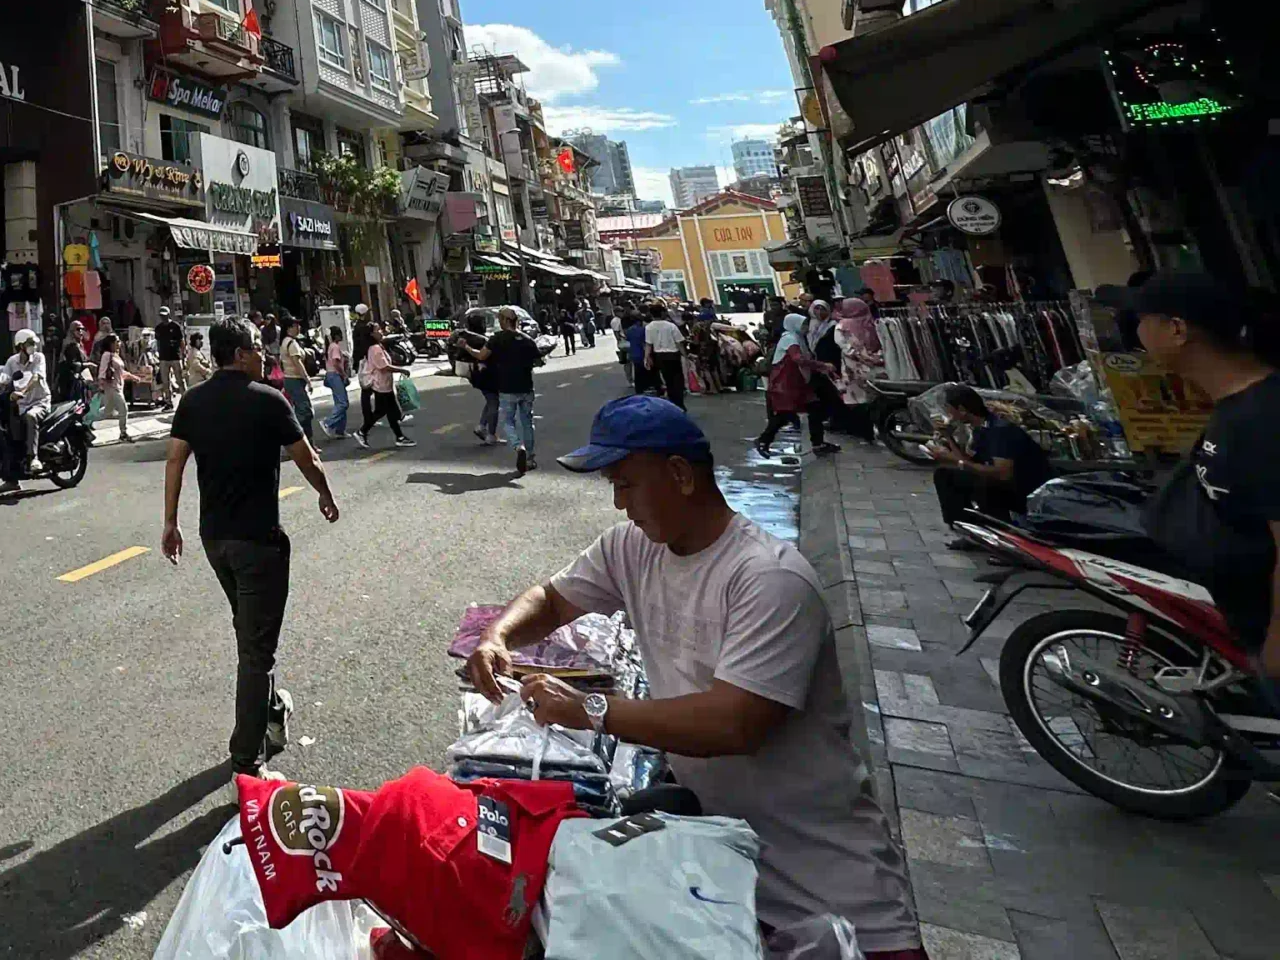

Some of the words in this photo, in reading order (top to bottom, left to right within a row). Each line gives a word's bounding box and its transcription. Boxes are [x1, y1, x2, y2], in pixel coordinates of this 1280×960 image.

[168, 78, 191, 105] Spa
[297, 215, 314, 232] SAZI
[315, 218, 331, 235] Hotel
[280, 800, 297, 840] CAFE
[479, 805, 508, 826] Polo
[246, 799, 277, 880] VIETNAM
[299, 805, 342, 893] Rock
